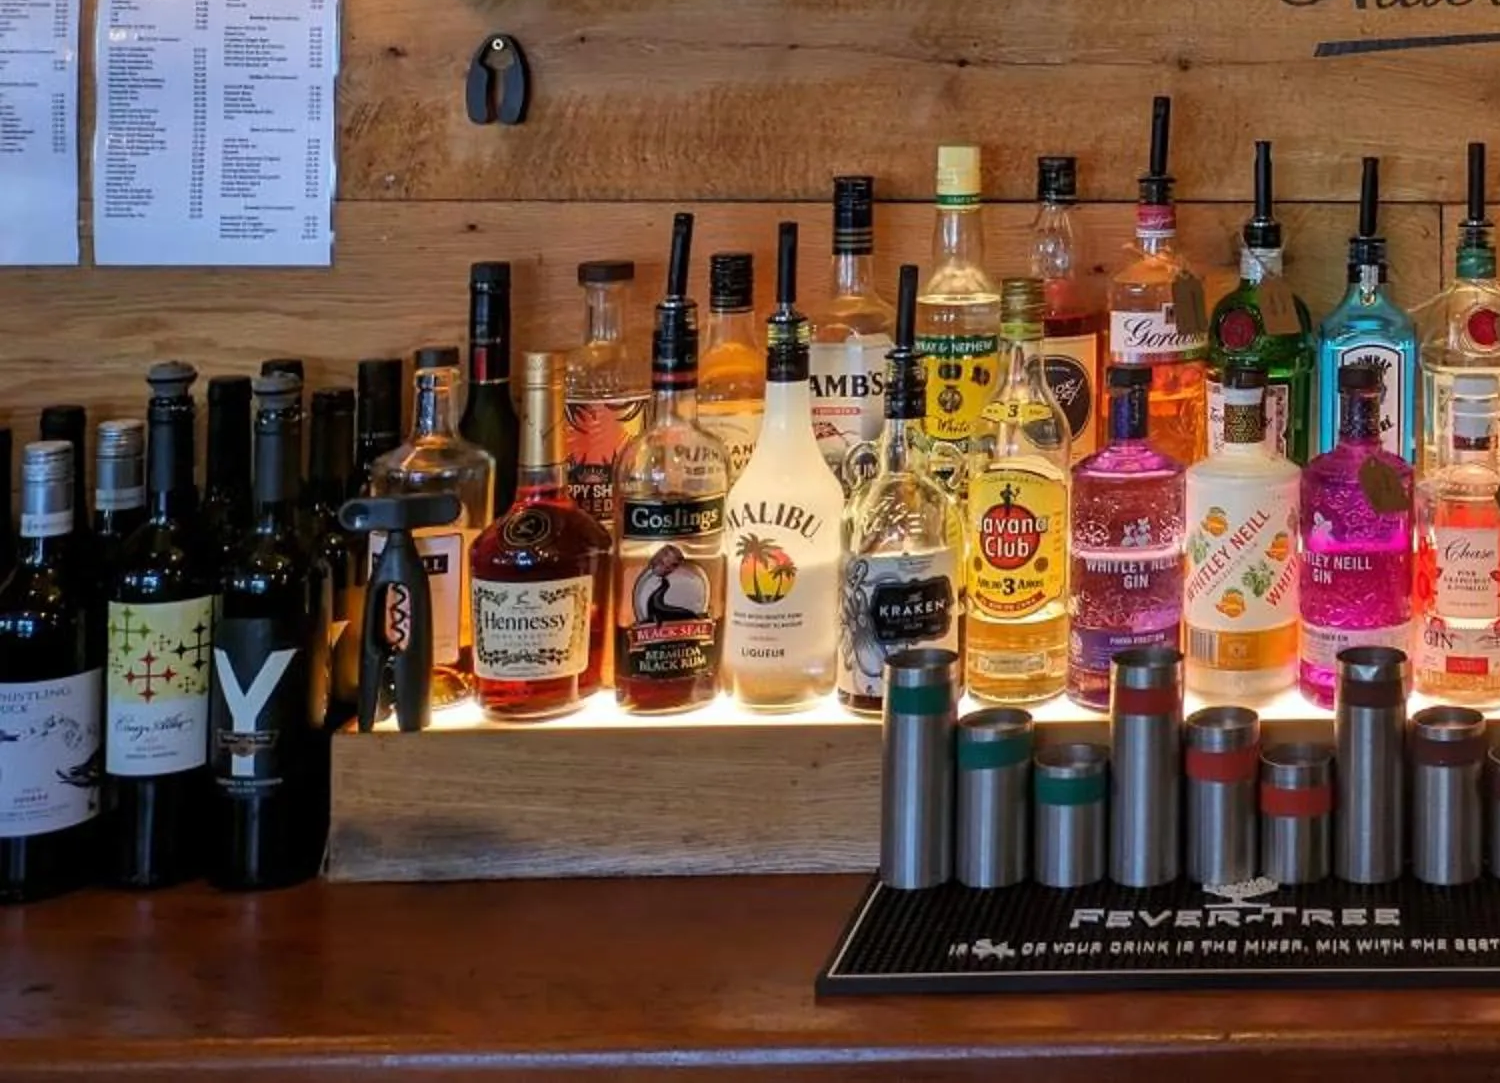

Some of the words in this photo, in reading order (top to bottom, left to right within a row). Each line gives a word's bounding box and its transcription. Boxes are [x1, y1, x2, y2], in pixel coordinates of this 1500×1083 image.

[631, 505, 721, 530] Goslings
[980, 515, 1049, 534] avana
[1229, 509, 1271, 552] NEILL
[984, 536, 1033, 557] Club
[1443, 535, 1496, 562] Chase
[1333, 555, 1373, 571] NEILL
[1003, 577, 1016, 597] 3
[1123, 574, 1150, 590] GIN
[1312, 569, 1333, 585] GIN
[879, 599, 946, 618] KRAKEN
[483, 610, 571, 632] Hennessy
[1424, 628, 1454, 650] GIN
[214, 648, 297, 776] Y
[1069, 906, 1401, 929] FEVER-TREE
[1052, 941, 1103, 956] YOUR
[1109, 940, 1170, 955] DRINK
[1200, 939, 1237, 955] THE
[1315, 938, 1351, 955] MIX
[1356, 938, 1405, 955] WITH
